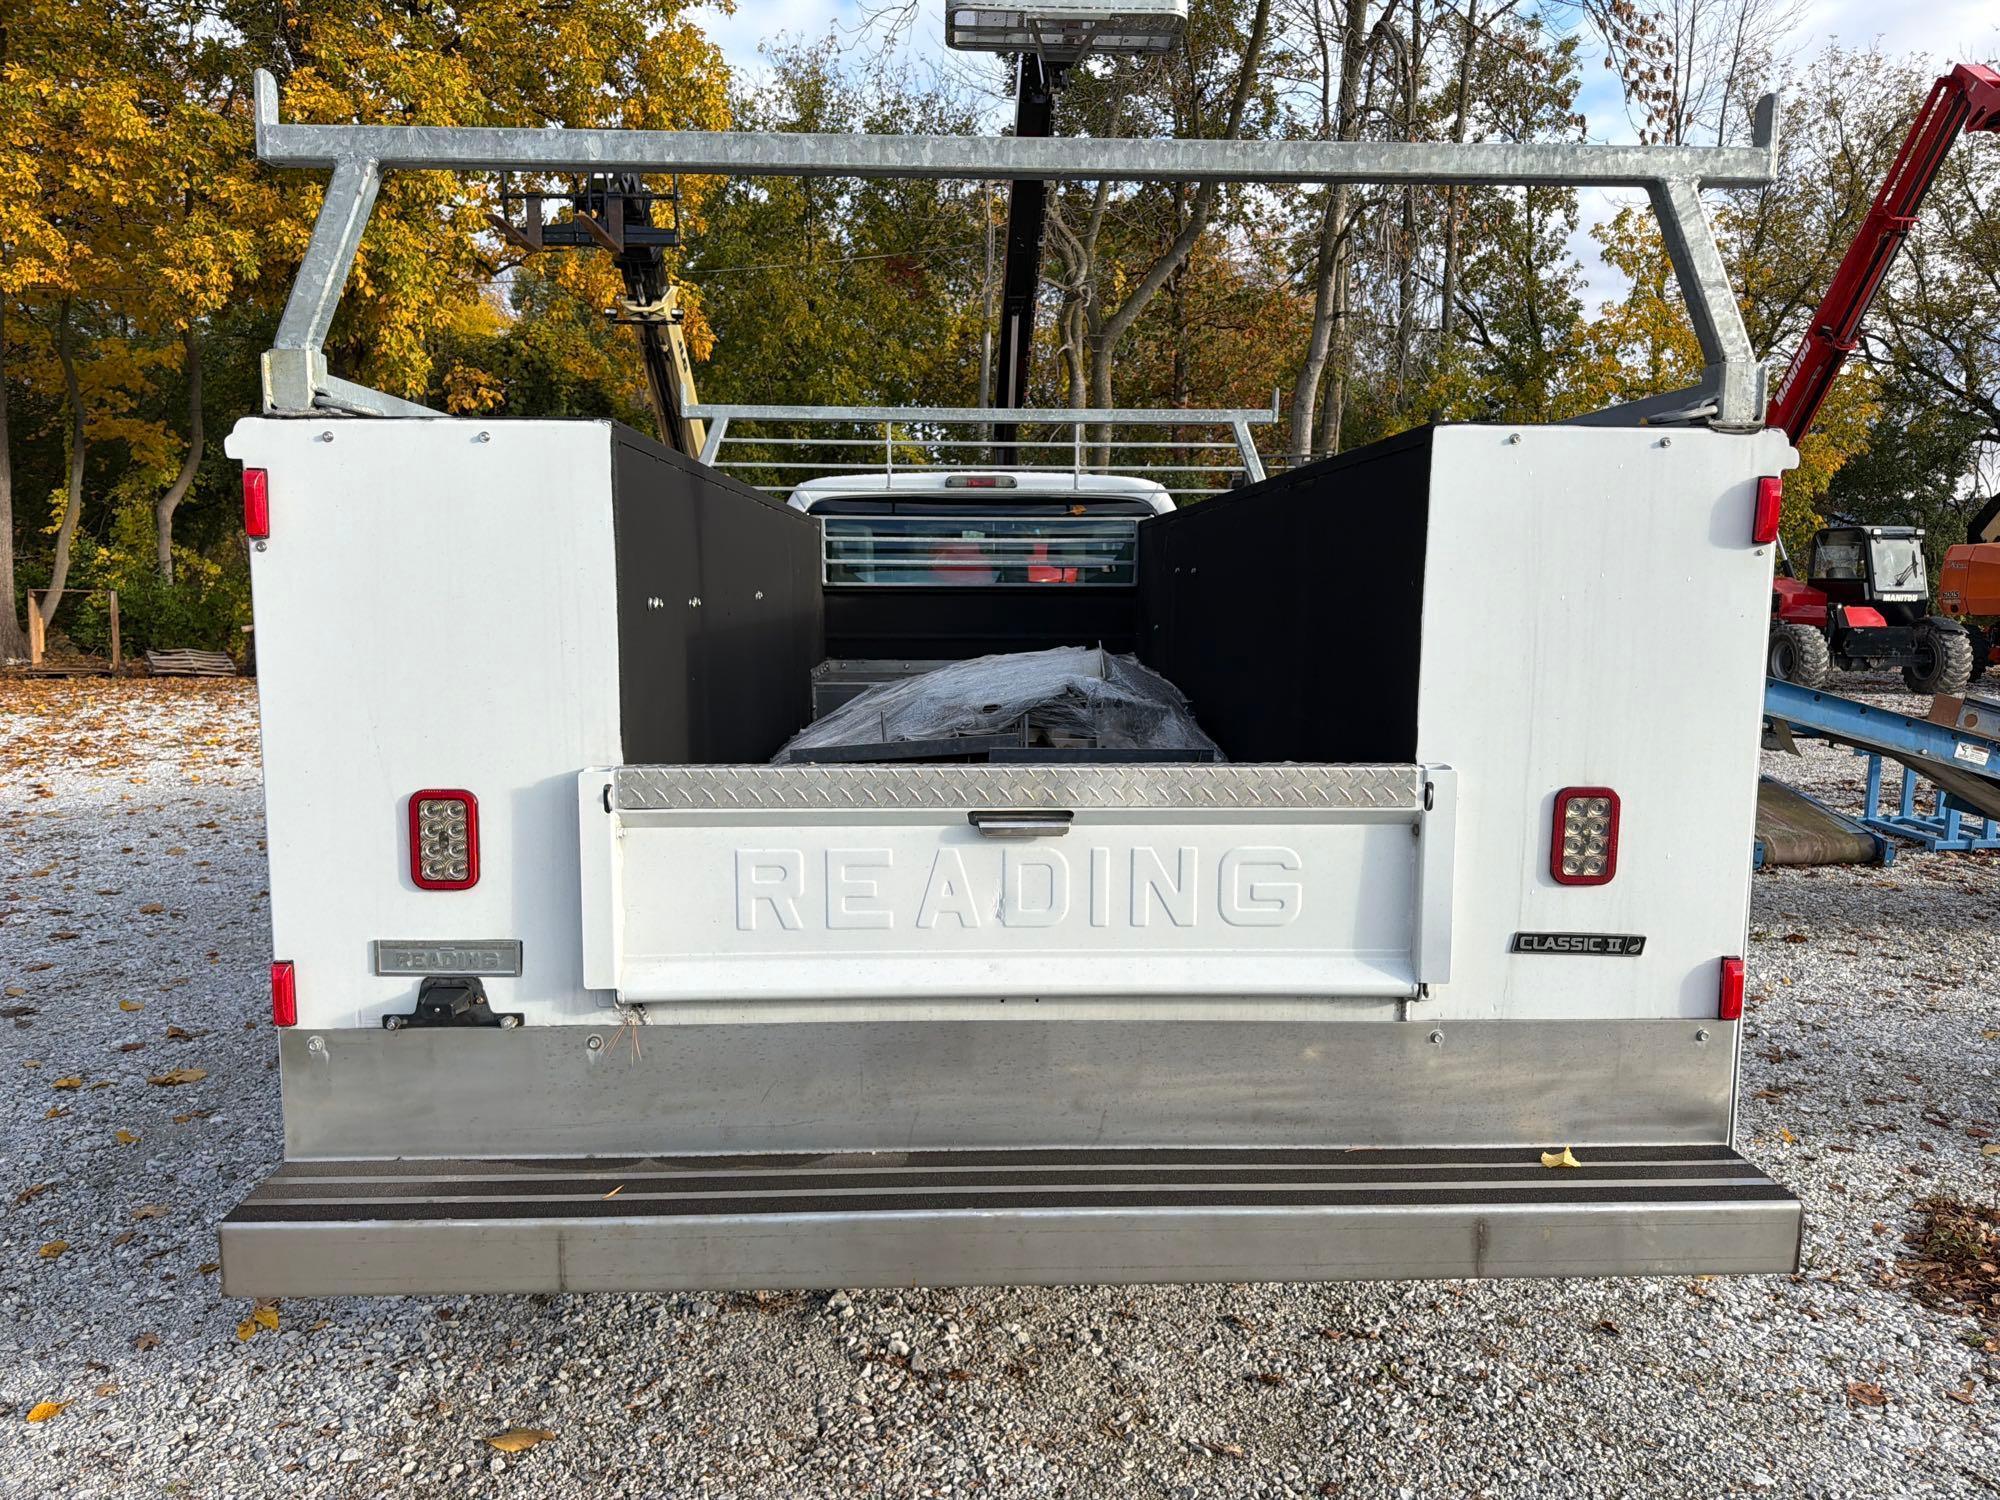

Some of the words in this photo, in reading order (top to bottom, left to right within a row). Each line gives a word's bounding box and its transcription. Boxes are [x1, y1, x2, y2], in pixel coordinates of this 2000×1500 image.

[1775, 338, 1811, 406] MANITOU
[1883, 594, 1918, 602] MANITOU
[735, 847, 1302, 931] READING
[1520, 936, 1601, 952] CLASSIC
[1606, 938, 1622, 952] II
[395, 952, 500, 968] READING
